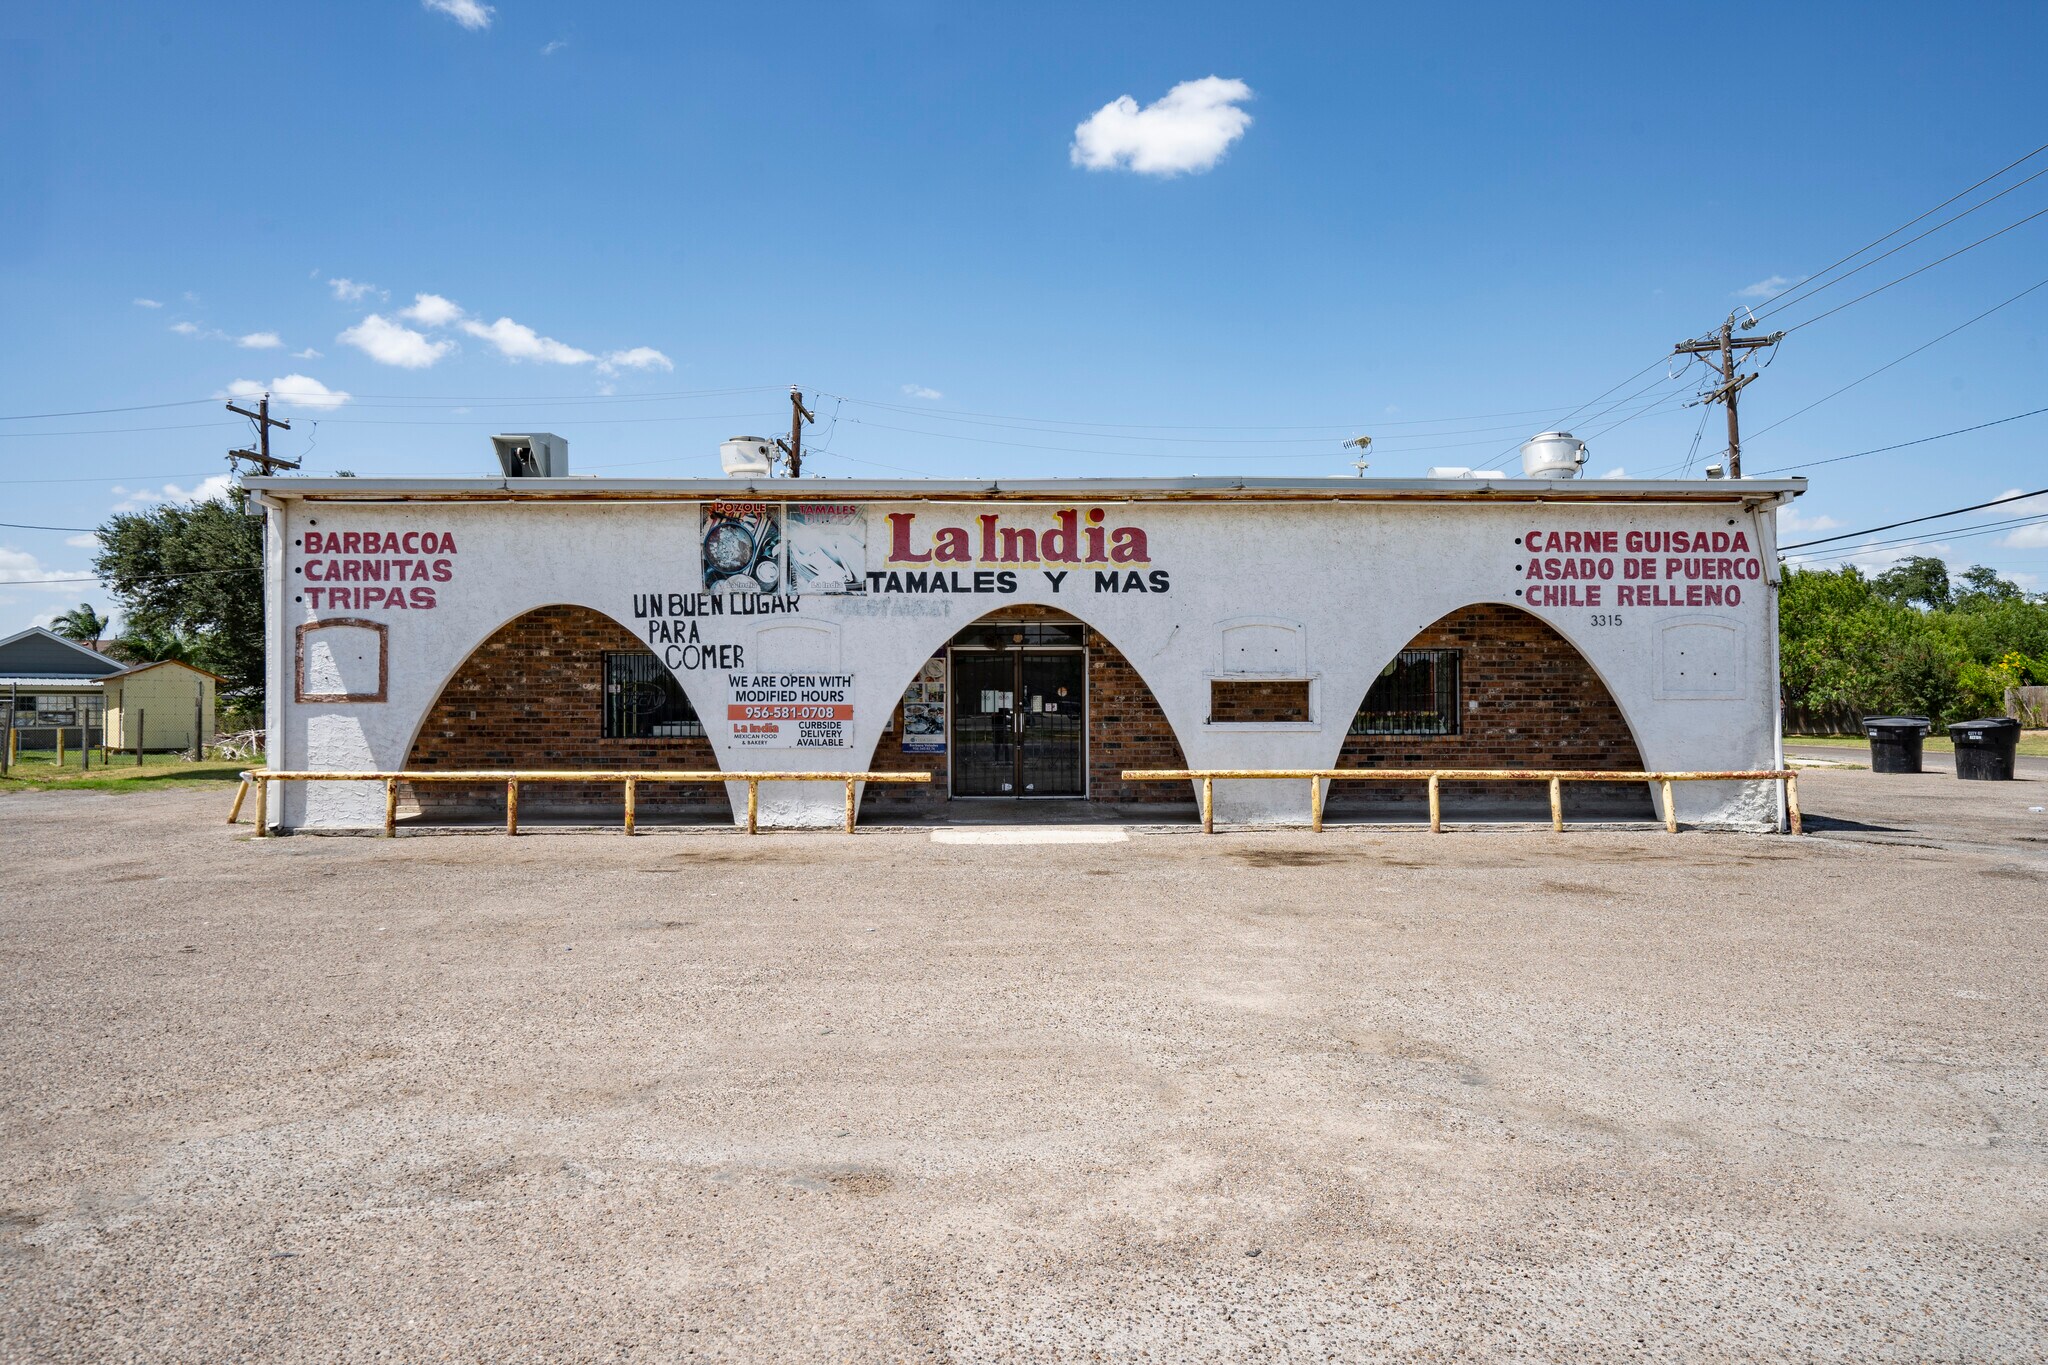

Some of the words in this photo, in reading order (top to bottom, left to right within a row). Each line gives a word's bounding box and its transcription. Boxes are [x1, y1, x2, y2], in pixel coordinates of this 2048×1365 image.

[716, 503, 767, 512] POZOLE
[800, 504, 856, 515] TAMALES
[304, 532, 457, 554] BARBACOA
[1525, 531, 1618, 553] CARNE
[1625, 531, 1750, 553] GUISADA
[304, 559, 453, 583] CARNITAS
[1525, 558, 1614, 580] ASADO
[1623, 558, 1656, 580] DE
[1665, 558, 1760, 580] PUERCO
[825, 581, 843, 589] India
[866, 571, 1017, 594] TAMALES
[1044, 571, 1069, 593] Y
[1094, 570, 1170, 594] MAS
[304, 587, 437, 610] TRIPAS
[1525, 585, 1601, 607] CHILE
[1617, 585, 1741, 607] RELLENO
[634, 593, 663, 618] UN
[668, 592, 724, 617] BUEN
[730, 592, 800, 615] LUGAR
[1590, 614, 1623, 627] 3315
[649, 620, 700, 644] PARA
[665, 644, 744, 670] COMER
[729, 675, 748, 687] WE
[752, 676, 776, 687] ARE
[780, 676, 815, 687] OPEN
[819, 676, 851, 687] WITH
[735, 690, 797, 702] MODIFIED
[801, 690, 844, 702] HOURS
[745, 707, 835, 719] 956-581-0708
[734, 723, 747, 733] La
[750, 723, 779, 733] India
[799, 721, 842, 730] CURBSIDE
[800, 730, 843, 738] DELIVERY
[796, 739, 844, 747] AVAILABLE
